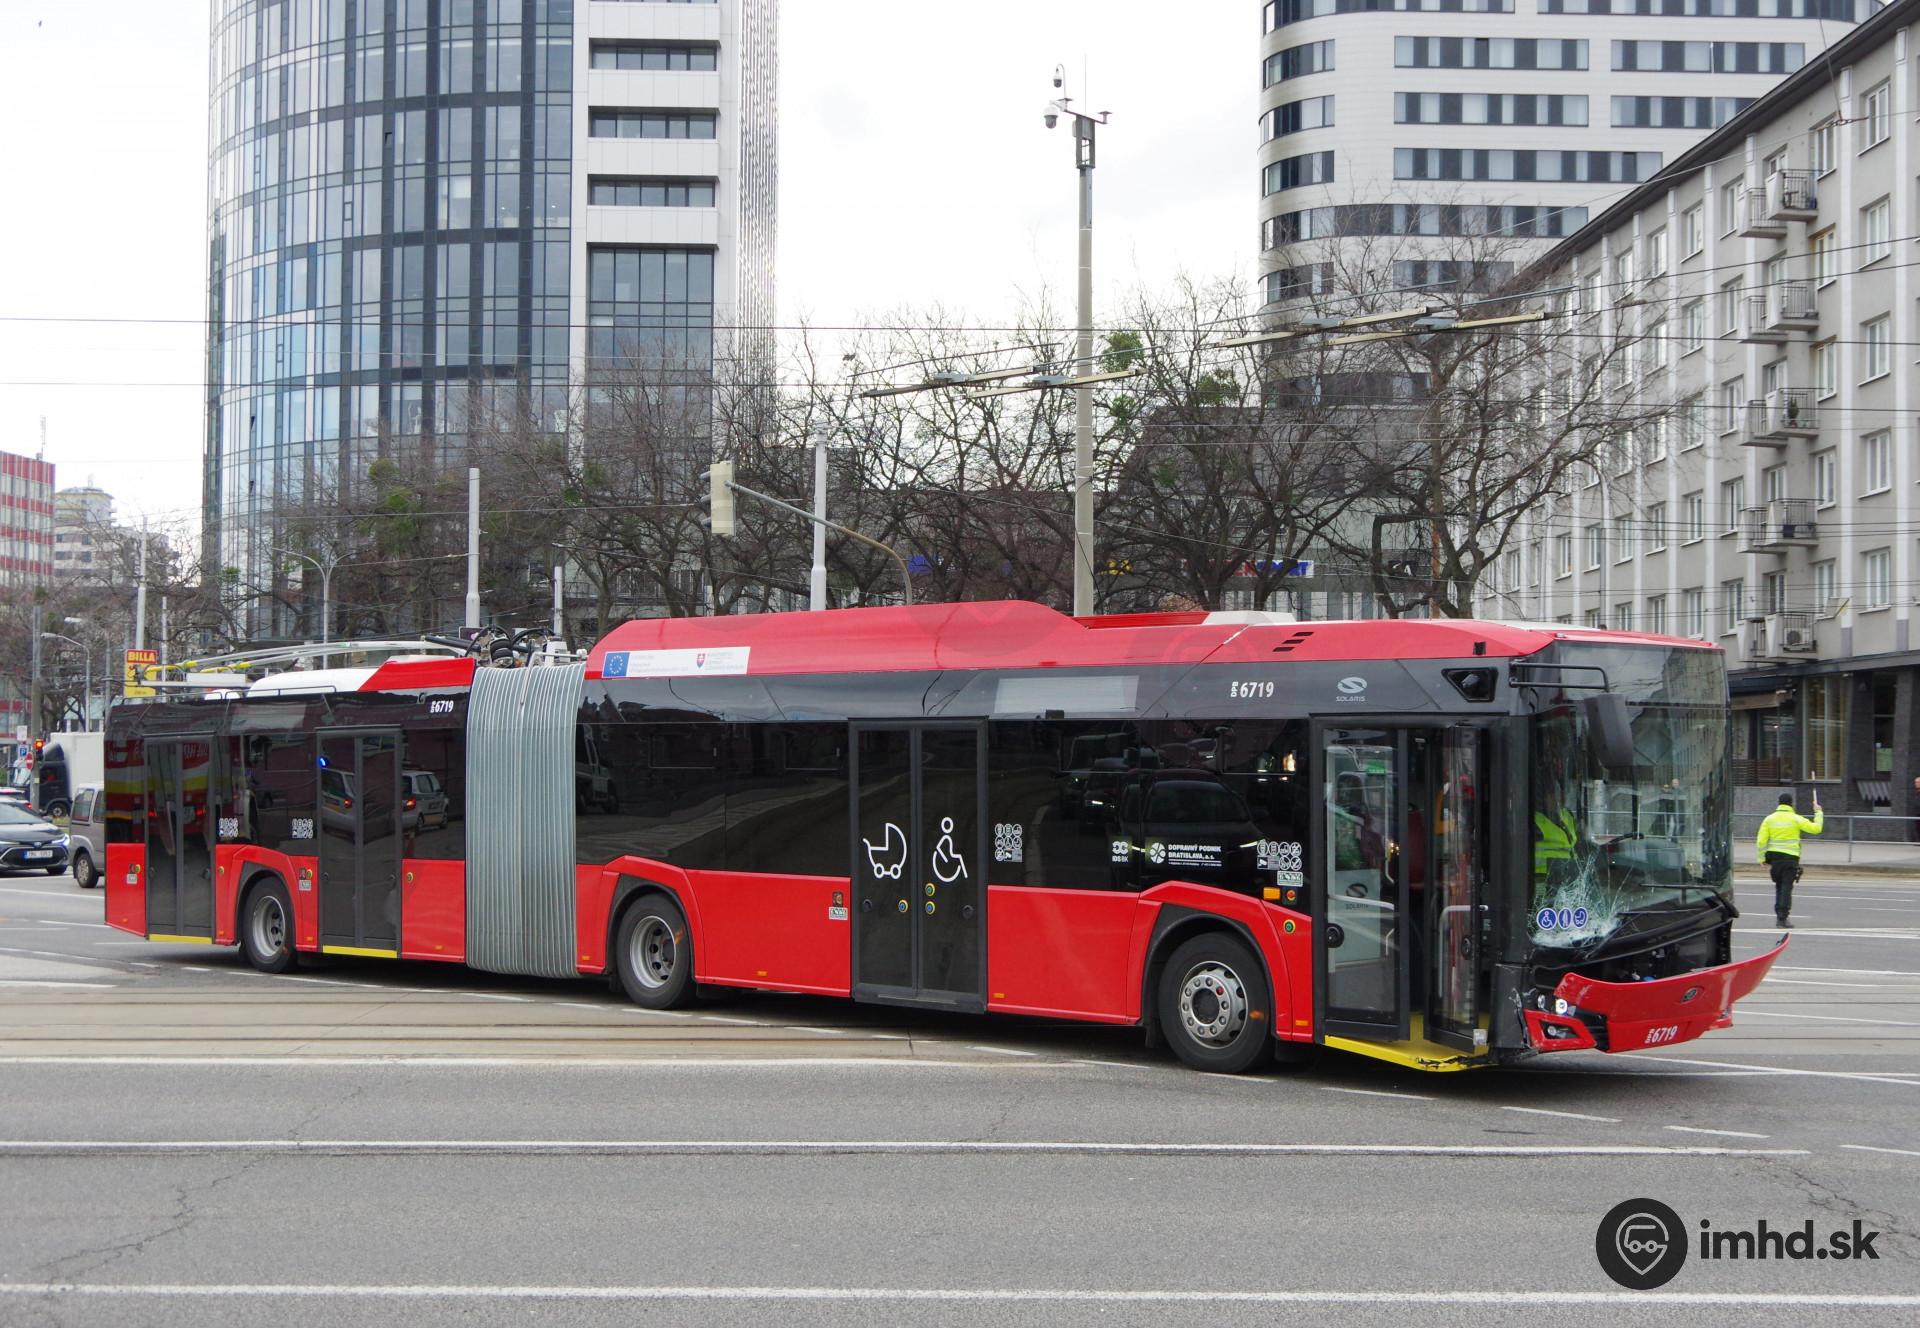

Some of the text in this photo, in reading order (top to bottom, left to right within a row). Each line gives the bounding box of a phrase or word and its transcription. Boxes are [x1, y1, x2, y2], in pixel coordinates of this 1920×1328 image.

[127, 651, 156, 662] BILLA
[1240, 681, 1275, 698] 6719
[435, 700, 454, 713] 6719
[1651, 1025, 1679, 1043] 6719
